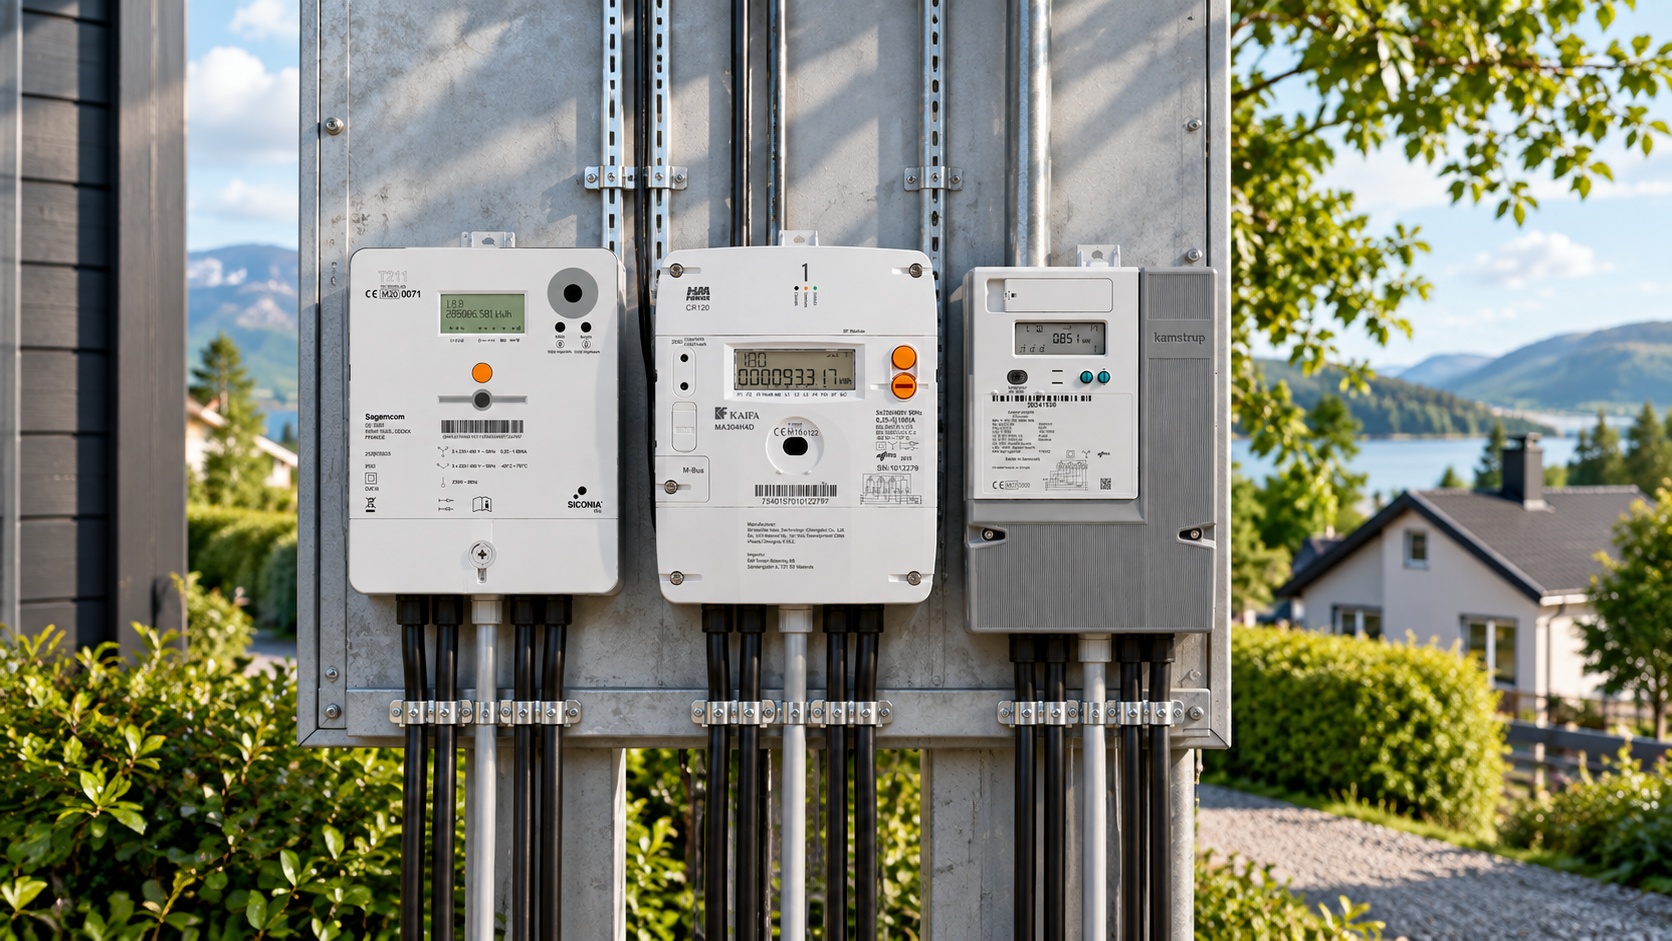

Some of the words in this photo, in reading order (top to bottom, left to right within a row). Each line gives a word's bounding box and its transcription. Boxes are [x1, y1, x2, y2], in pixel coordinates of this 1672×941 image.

[802, 263, 808, 282] 1
[401, 290, 421, 298] 0071
[1154, 332, 1206, 344] kamstrup
[730, 412, 760, 420] KAIFA
